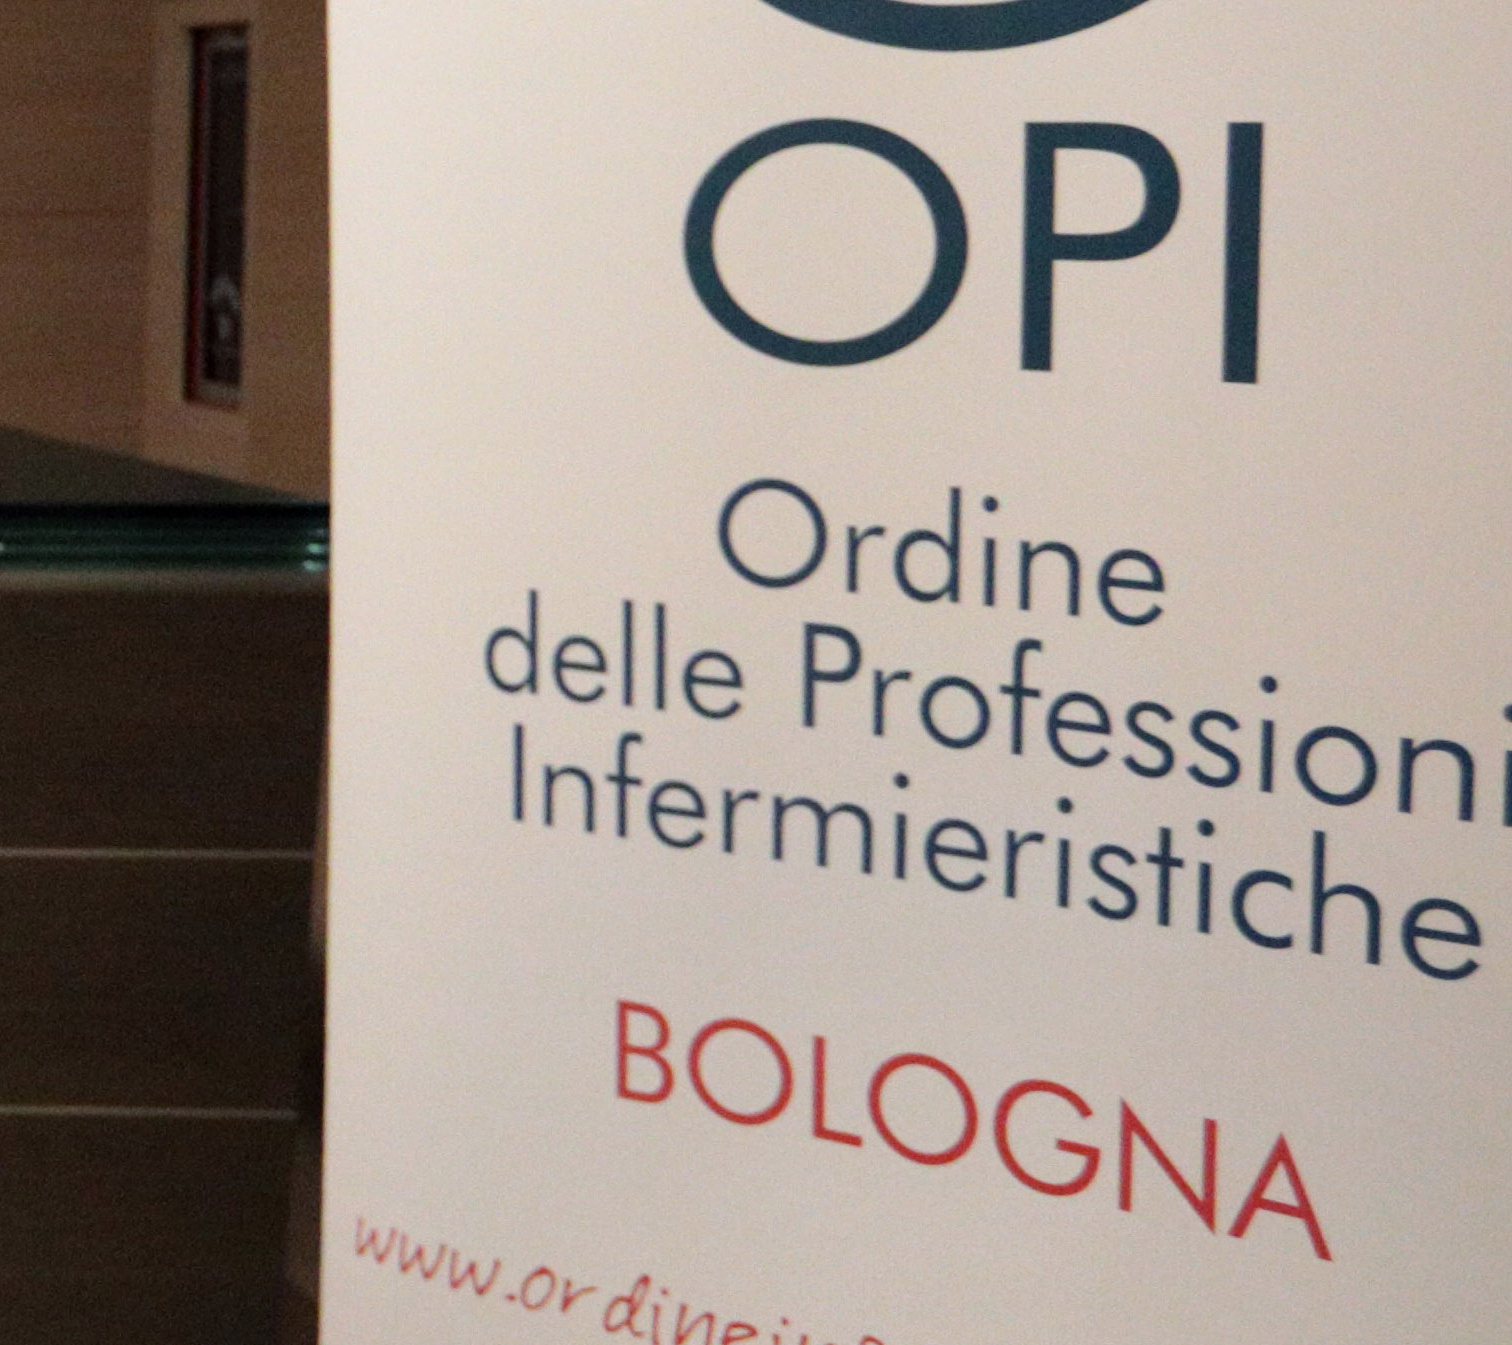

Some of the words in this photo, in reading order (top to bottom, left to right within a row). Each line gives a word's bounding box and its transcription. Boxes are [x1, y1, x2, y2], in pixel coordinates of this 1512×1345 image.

[683, 117, 1266, 385] OPI
[485, 589, 745, 720] delle
[718, 478, 1166, 627] Ordine
[512, 723, 1483, 981] Infermieristiche
[616, 999, 1333, 1262] BOLOGNA
